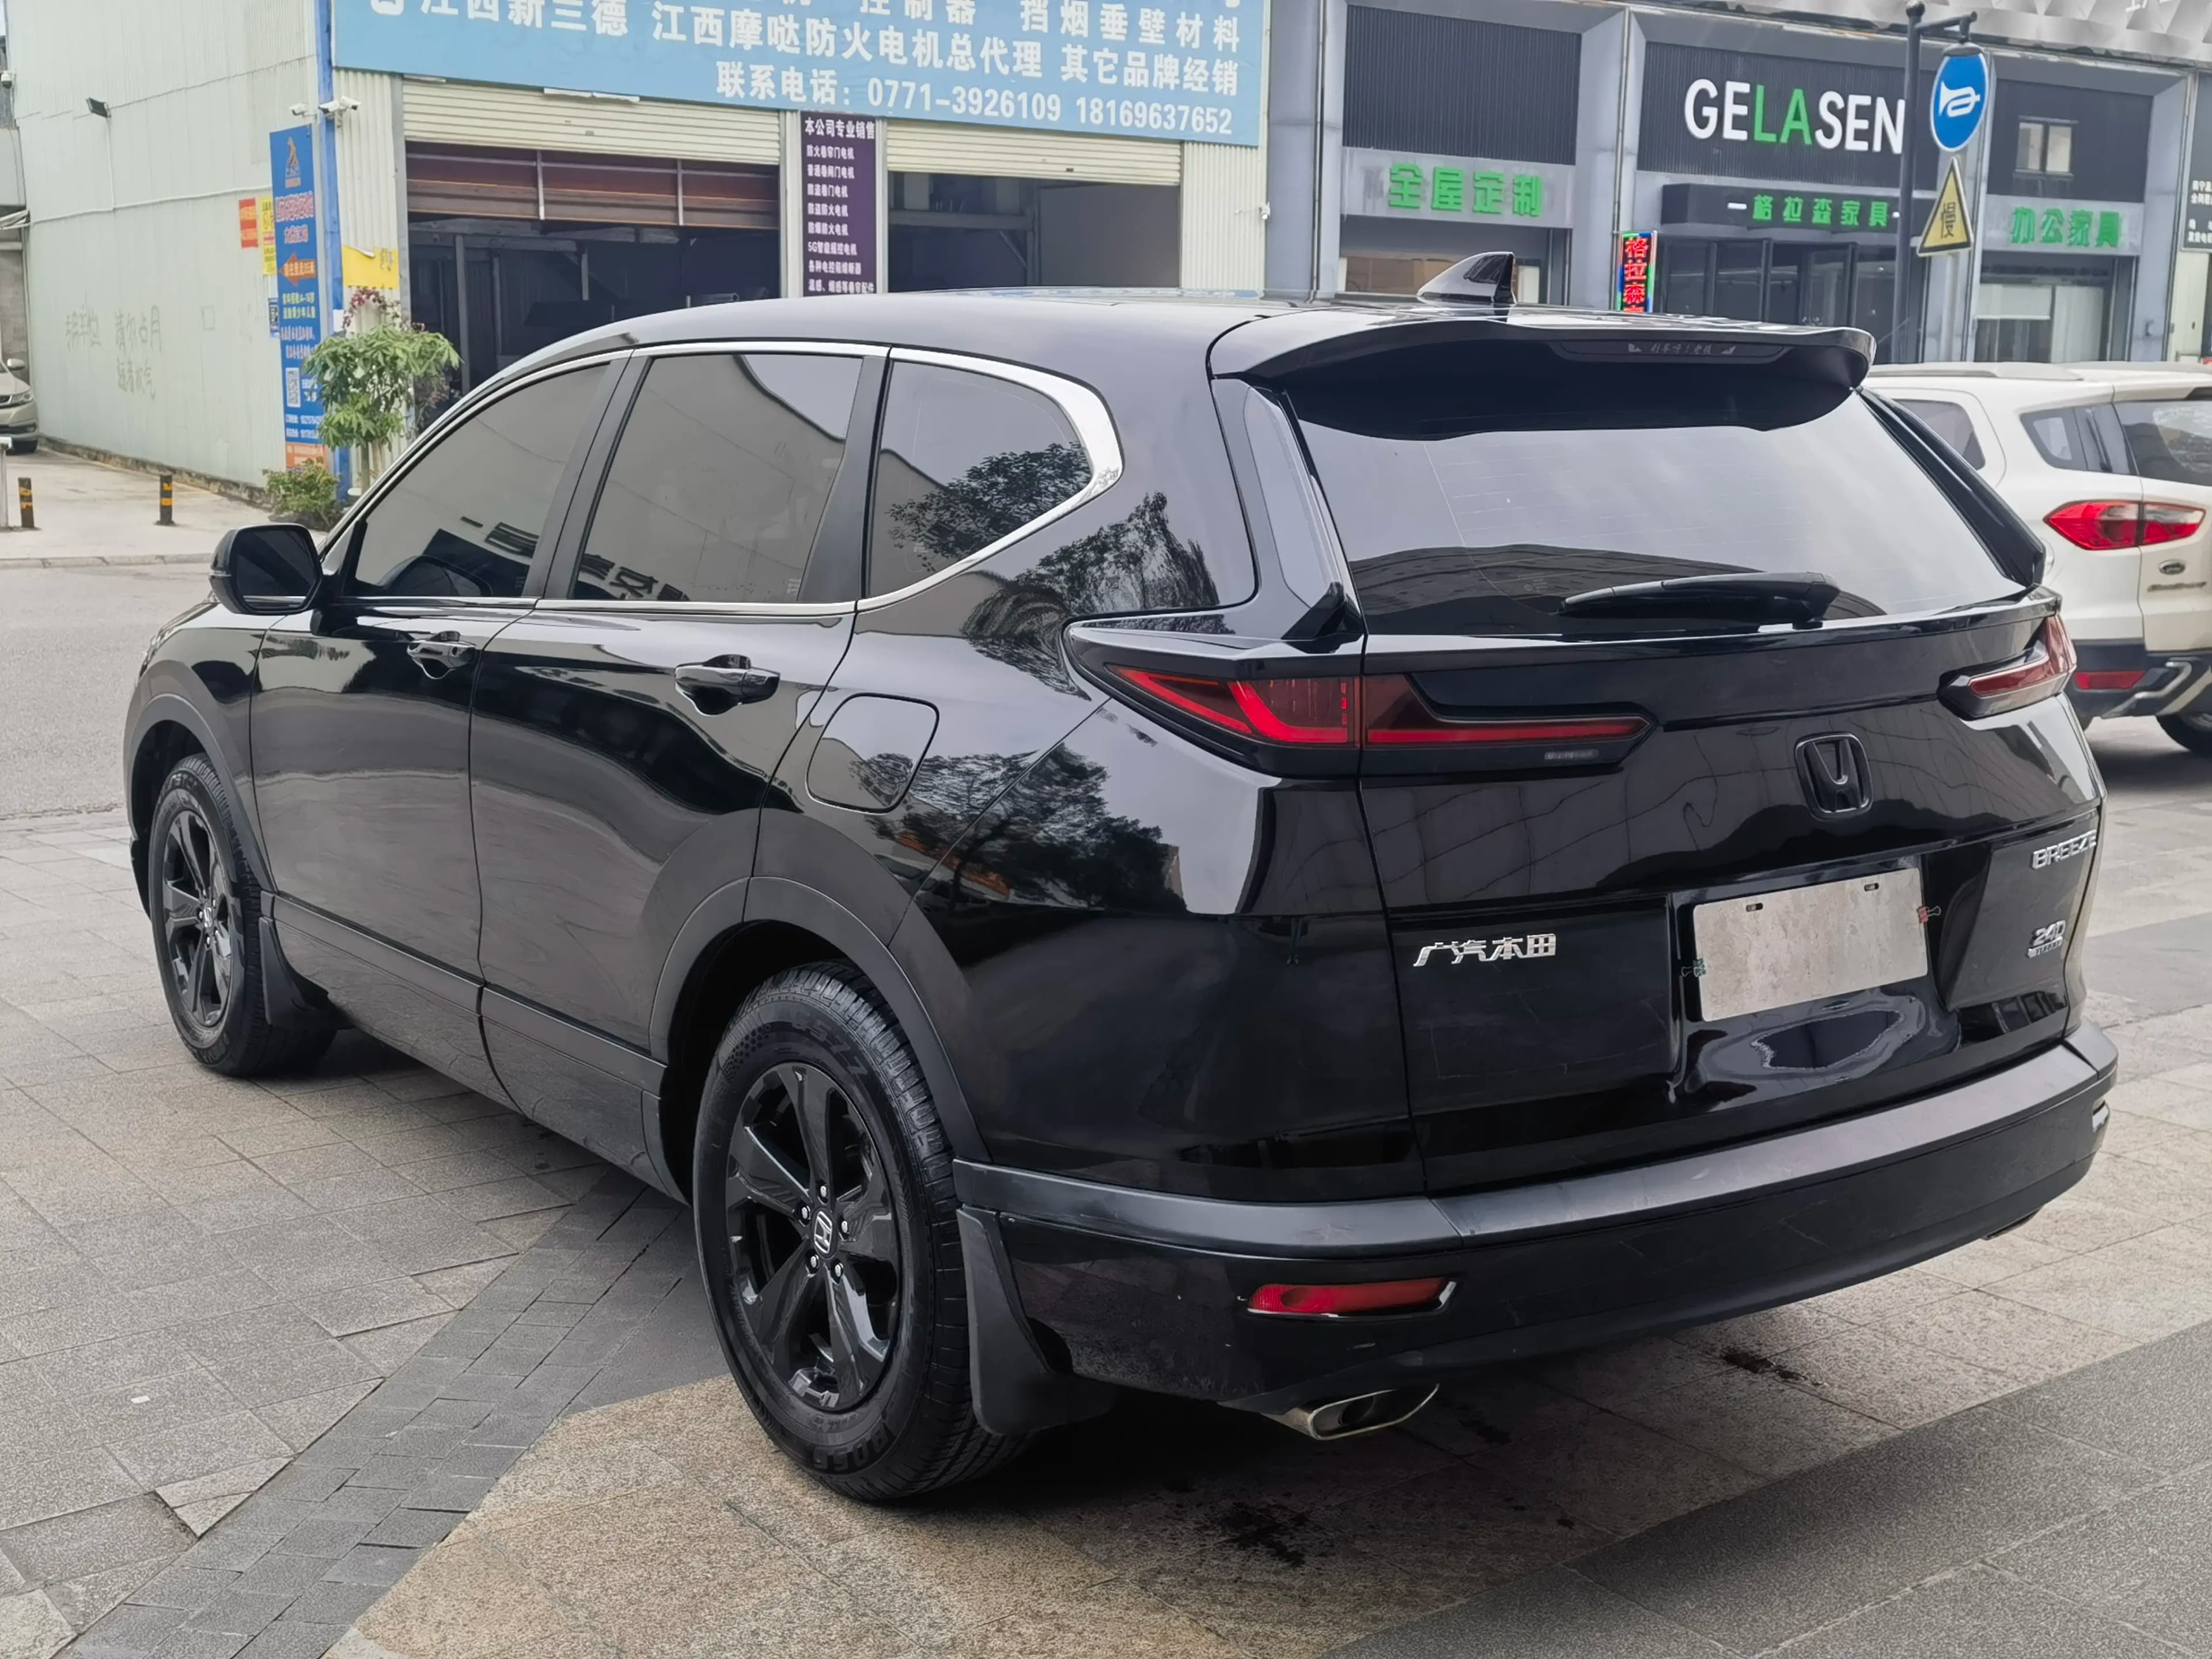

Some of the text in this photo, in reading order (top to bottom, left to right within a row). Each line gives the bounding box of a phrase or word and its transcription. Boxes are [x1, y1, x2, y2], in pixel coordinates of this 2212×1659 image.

[1020, 0, 1240, 53] 挡烟垂壁材料
[652, 1, 1238, 97] 江西摩哒防火电机总代理 其它品牌经销
[868, 77, 1061, 122] 0771-3926109
[1076, 97, 1233, 135] 18169637652
[1684, 78, 1906, 154] GELASEN
[805, 117, 875, 139] 本公司专业销售
[1389, 163, 1543, 217] 全屋定制
[1752, 194, 1889, 228] 格拉森家具
[1940, 202, 1956, 239] 慢
[2010, 206, 2120, 248] 办公家具
[2032, 829, 2097, 869] BREEZE
[1413, 933, 1555, 967] 广汽本田
